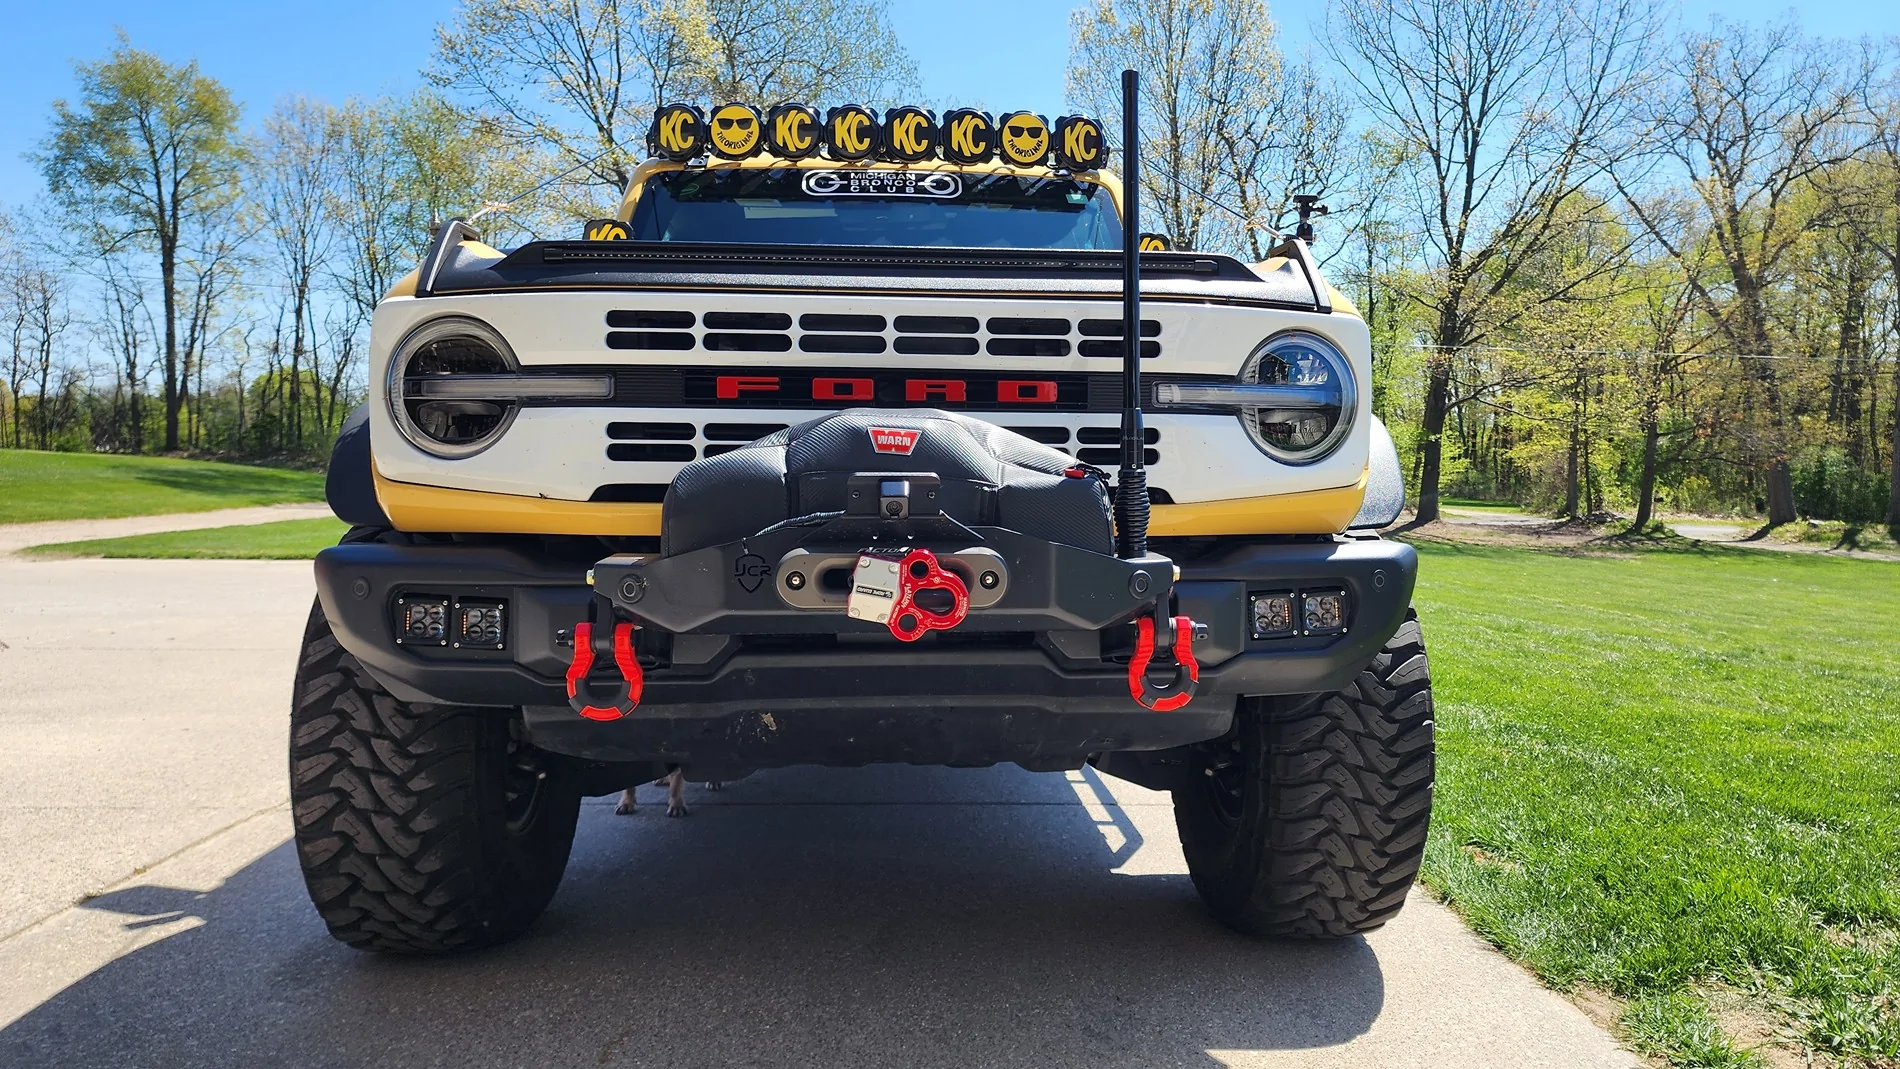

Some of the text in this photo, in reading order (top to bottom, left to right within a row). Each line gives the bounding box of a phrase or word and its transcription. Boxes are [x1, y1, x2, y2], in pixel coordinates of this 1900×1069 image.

[660, 110, 694, 152] KC
[776, 109, 812, 152] KC
[835, 111, 871, 153] KC
[893, 113, 929, 155] KC
[951, 115, 986, 157] KC
[1065, 121, 1097, 163] KC
[850, 172, 916, 180] MICHIGAN
[850, 179, 916, 187] BRONCO
[850, 185, 915, 193] CLUB
[717, 376, 1058, 403] FORD
[877, 435, 911, 447] WARN
[734, 563, 772, 577] JCR
